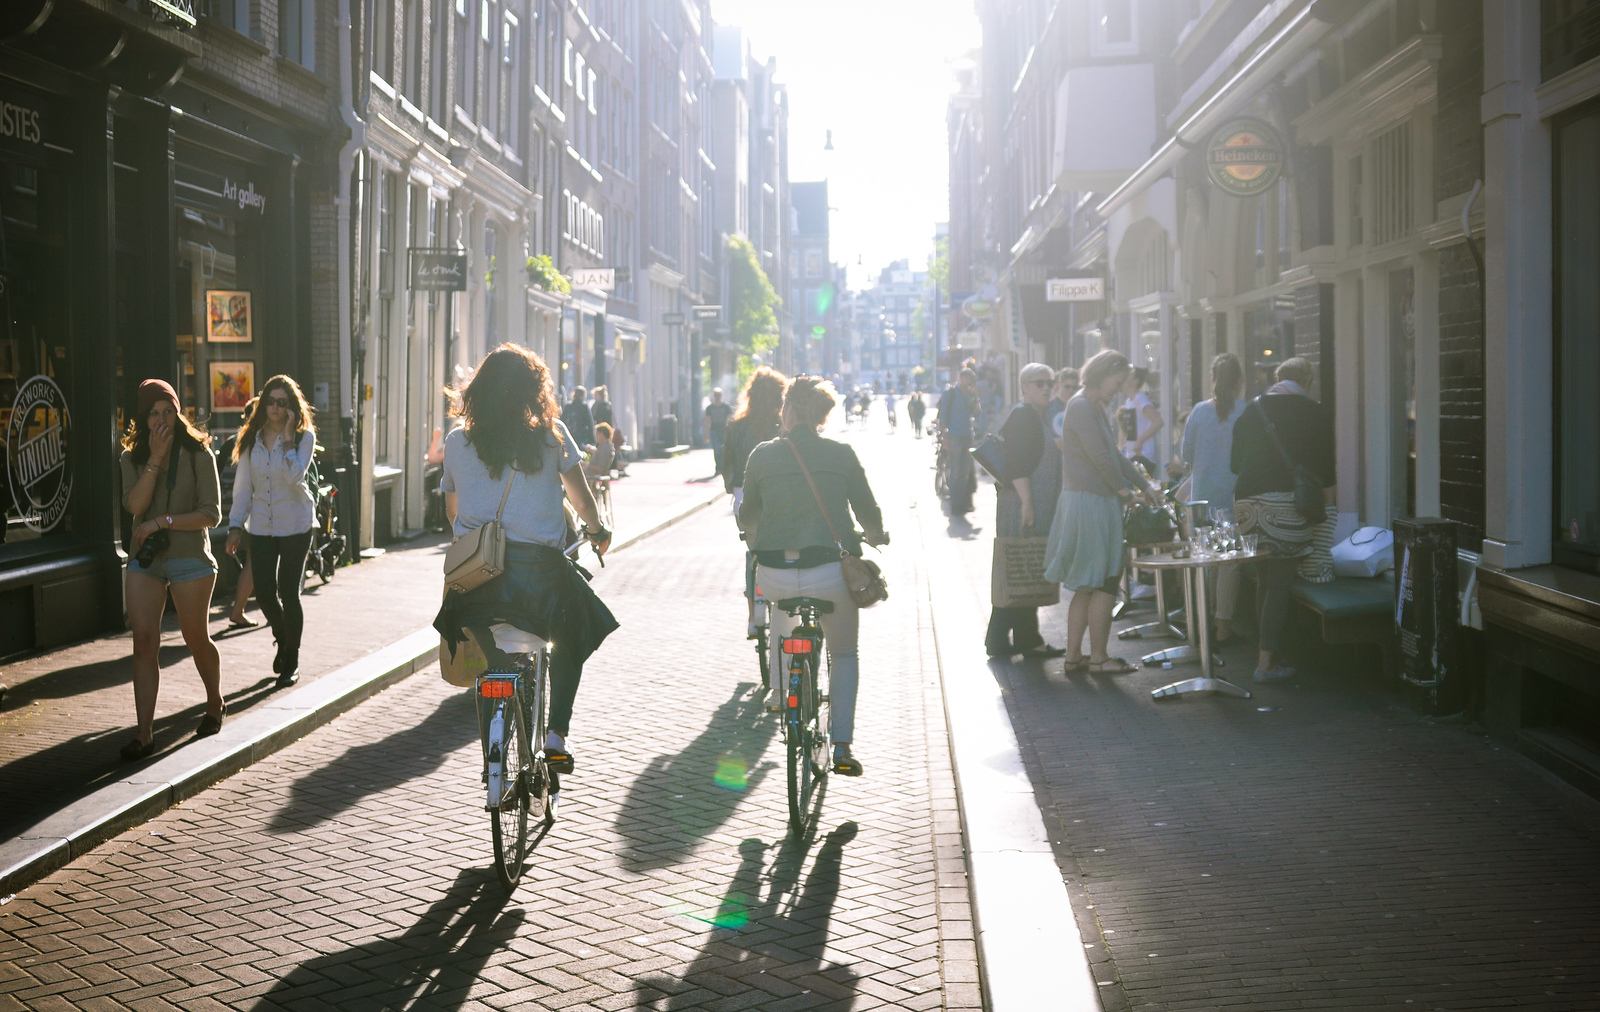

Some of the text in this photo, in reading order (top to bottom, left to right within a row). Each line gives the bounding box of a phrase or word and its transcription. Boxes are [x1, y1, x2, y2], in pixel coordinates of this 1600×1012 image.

[1215, 150, 1276, 161] Heineken
[223, 176, 266, 215] Art gallery
[575, 273, 610, 285] JAN
[1051, 282, 1098, 297] Filippa K
[13, 383, 56, 432] ARTWORKS
[17, 429, 67, 486] UNIQUE
[25, 482, 70, 529] ARTWORKS
